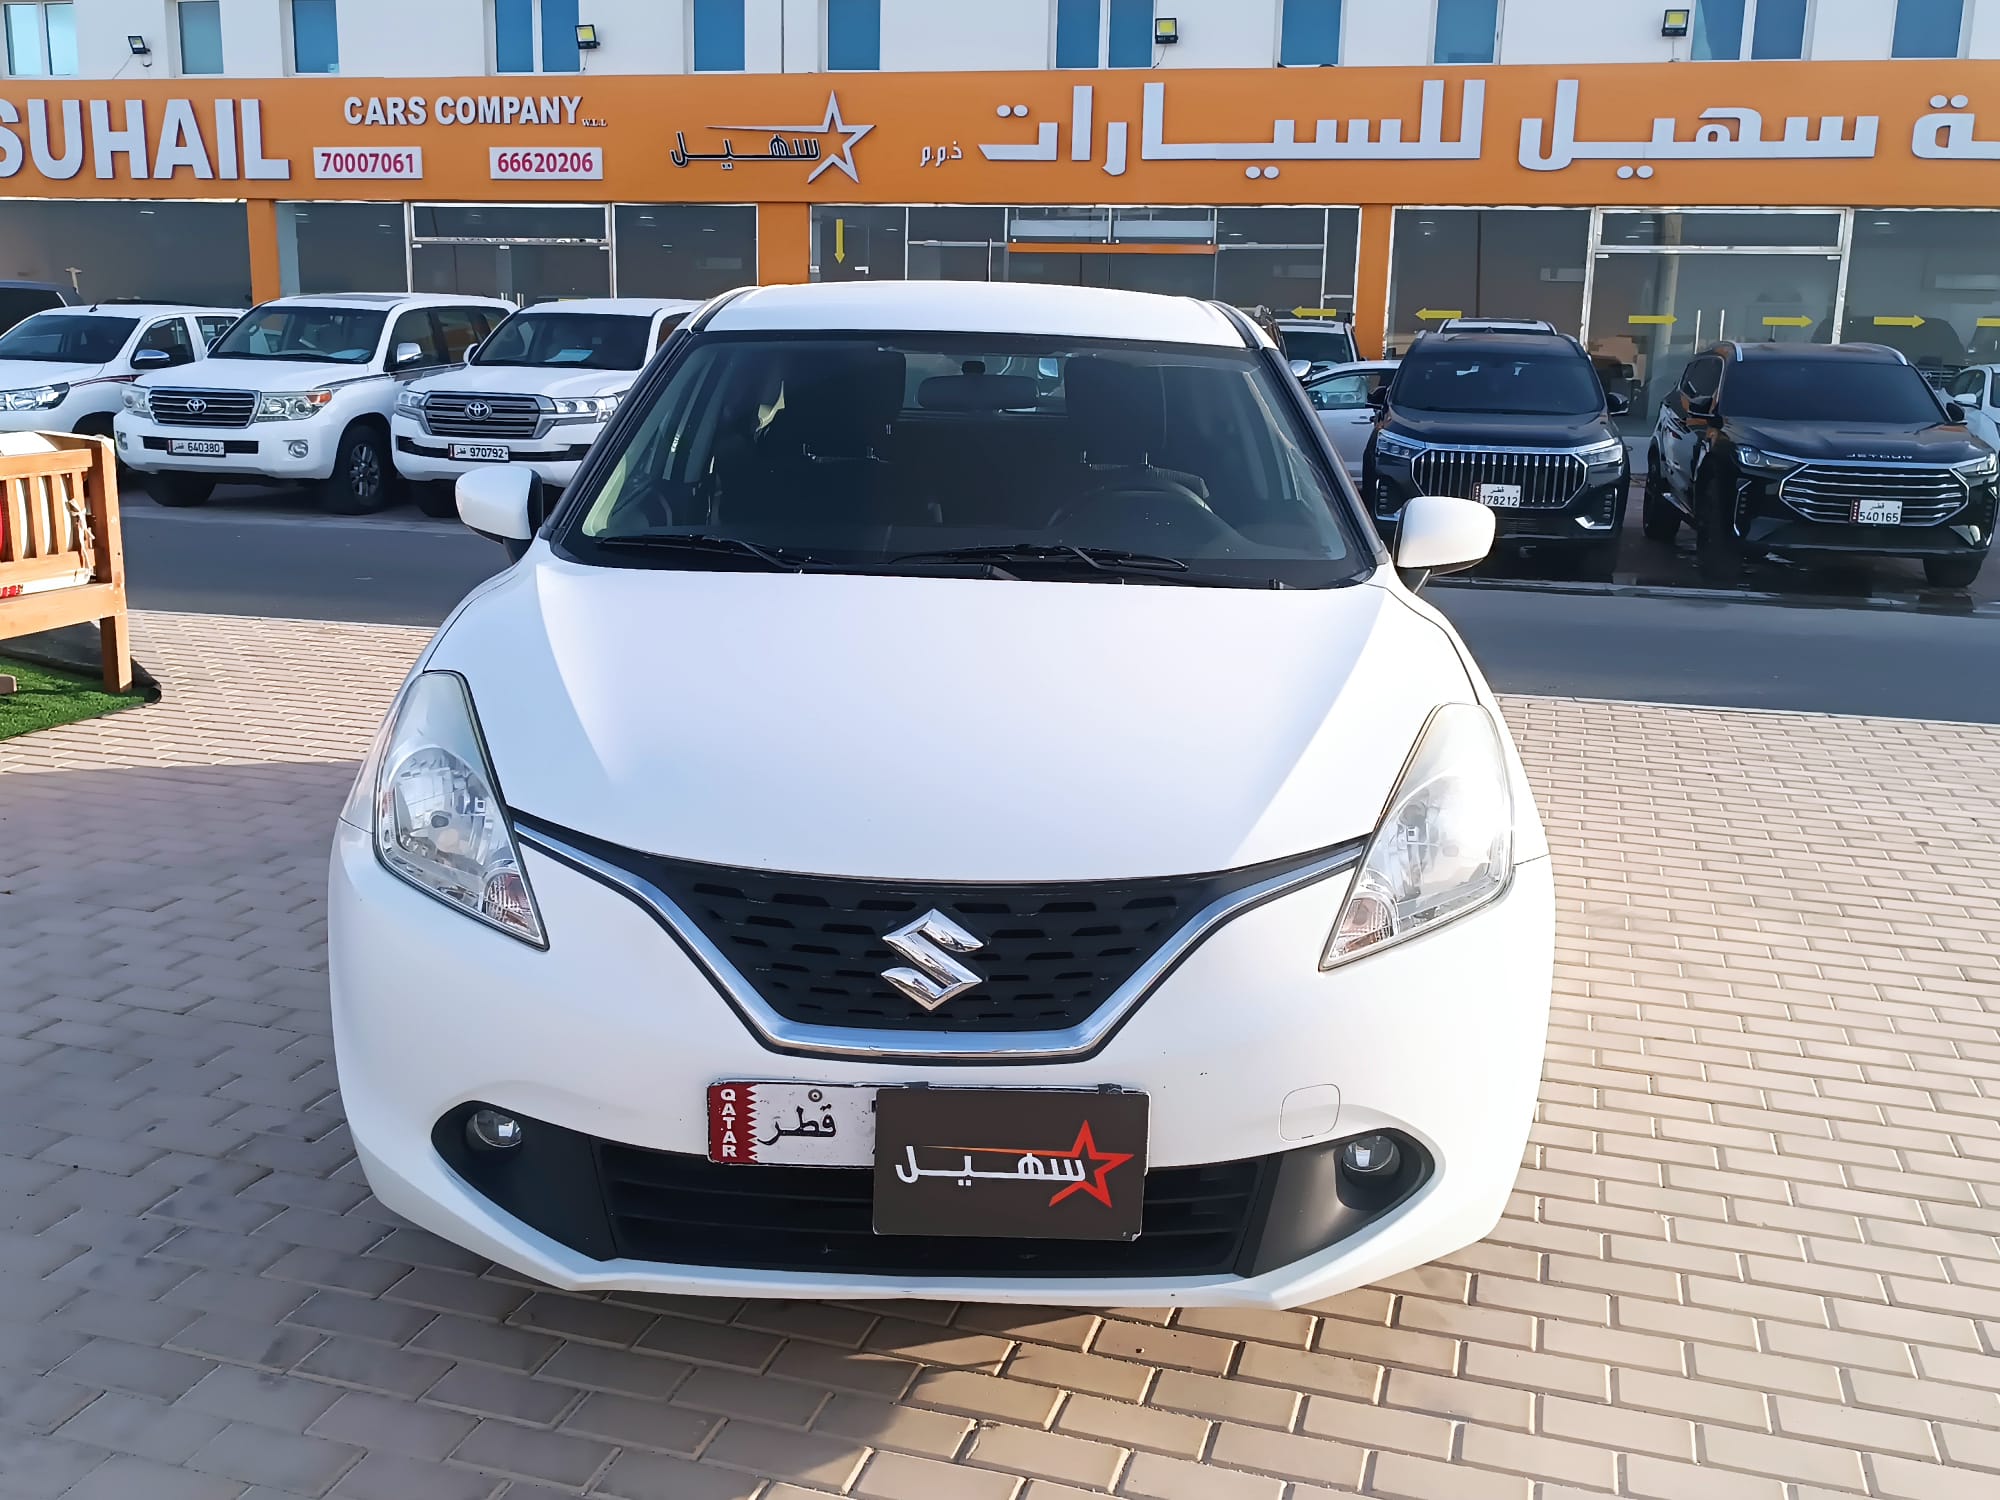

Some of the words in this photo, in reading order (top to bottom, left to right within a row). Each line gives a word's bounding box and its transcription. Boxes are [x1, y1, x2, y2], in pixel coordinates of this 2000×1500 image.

[344, 97, 427, 125] CARS
[435, 95, 582, 125] COMPANY
[1911, 94, 2000, 160] ة
[977, 79, 1486, 180] للسيارات
[1517, 79, 1879, 179] سهيل
[321, 152, 415, 174] 70007061
[497, 151, 594, 173] 66620206
[669, 130, 820, 170] سهيل
[187, 442, 220, 453] 640380
[470, 447, 505, 459] 970792
[1482, 495, 1518, 507] 178212
[1859, 511, 1899, 523] 540165
[720, 1088, 738, 1158] QATAR
[757, 1103, 837, 1146] قطر
[895, 1145, 1085, 1187] سهيل
